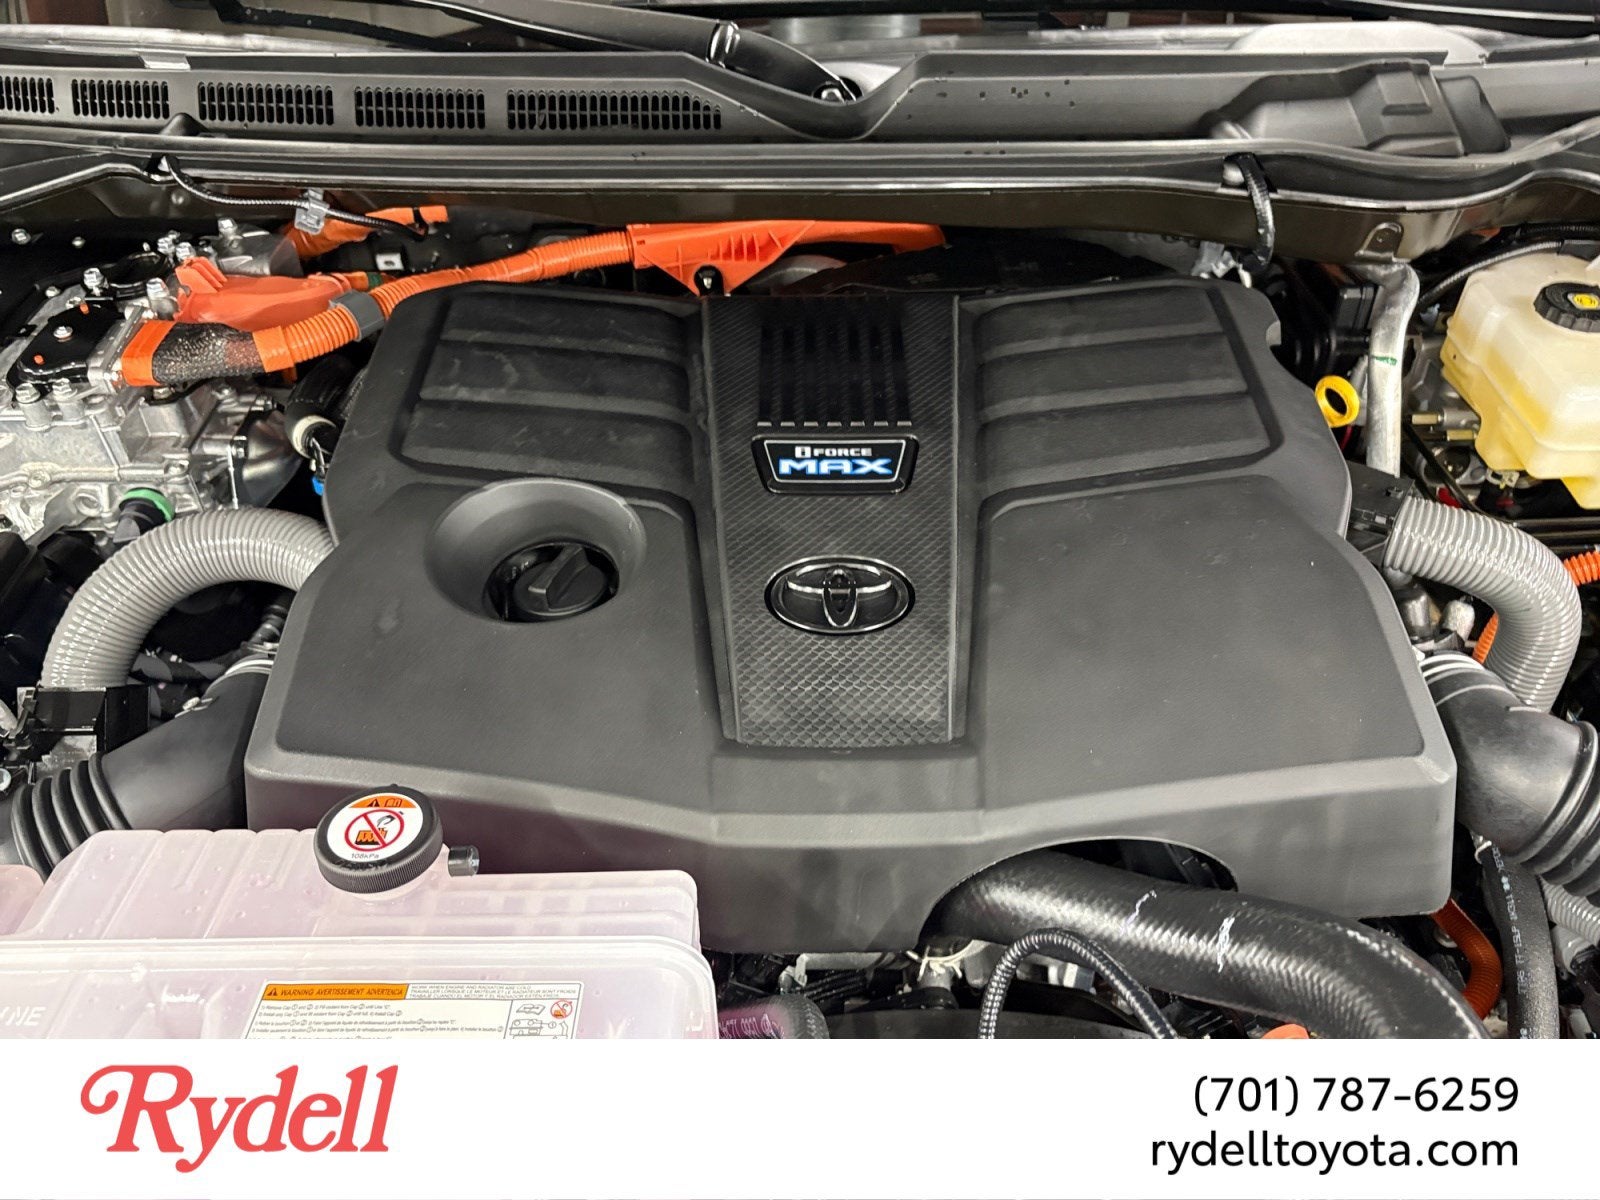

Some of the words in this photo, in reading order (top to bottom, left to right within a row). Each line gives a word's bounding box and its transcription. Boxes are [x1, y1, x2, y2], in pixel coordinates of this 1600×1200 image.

[779, 458, 893, 475] MAX
[281, 988, 314, 996] WARNING
[315, 988, 364, 996] AVERTISSEMENT
[367, 988, 403, 996] ADVERTENCIA
